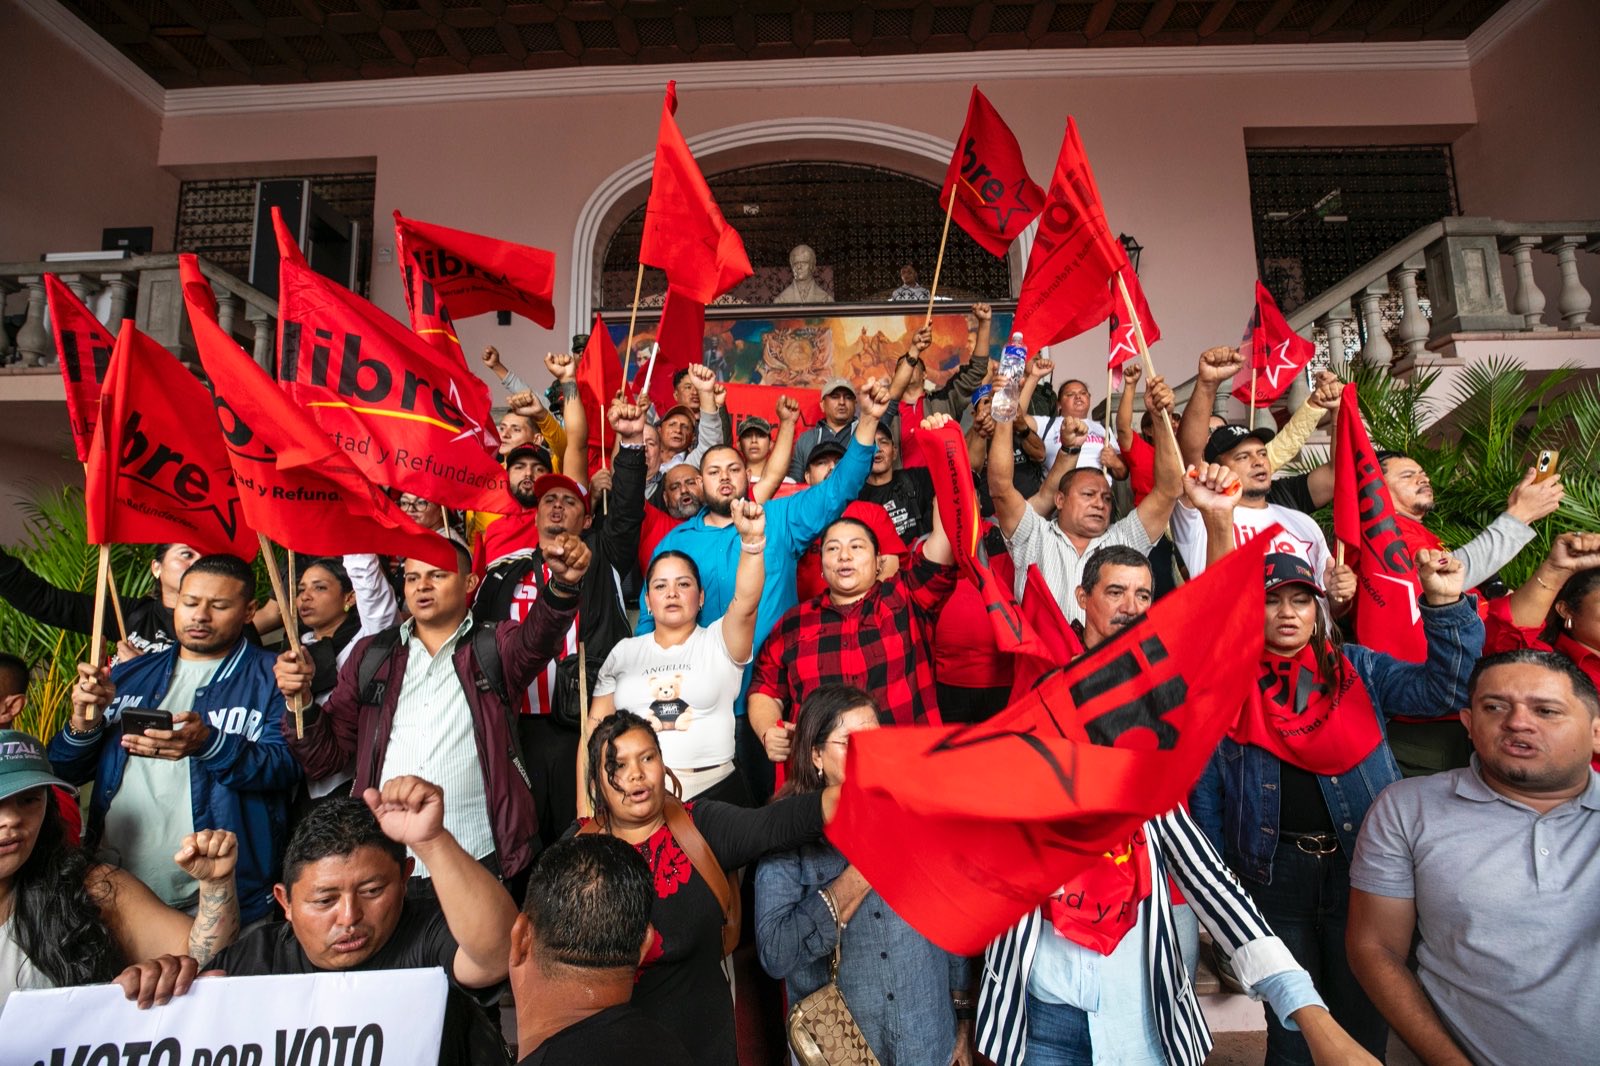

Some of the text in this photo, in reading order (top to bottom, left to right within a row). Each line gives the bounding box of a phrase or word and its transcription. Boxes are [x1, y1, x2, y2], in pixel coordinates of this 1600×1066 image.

[280, 320, 466, 428] libre
[376, 446, 390, 464] y
[642, 663, 692, 676] ANGELUS
[208, 706, 264, 742] YOR
